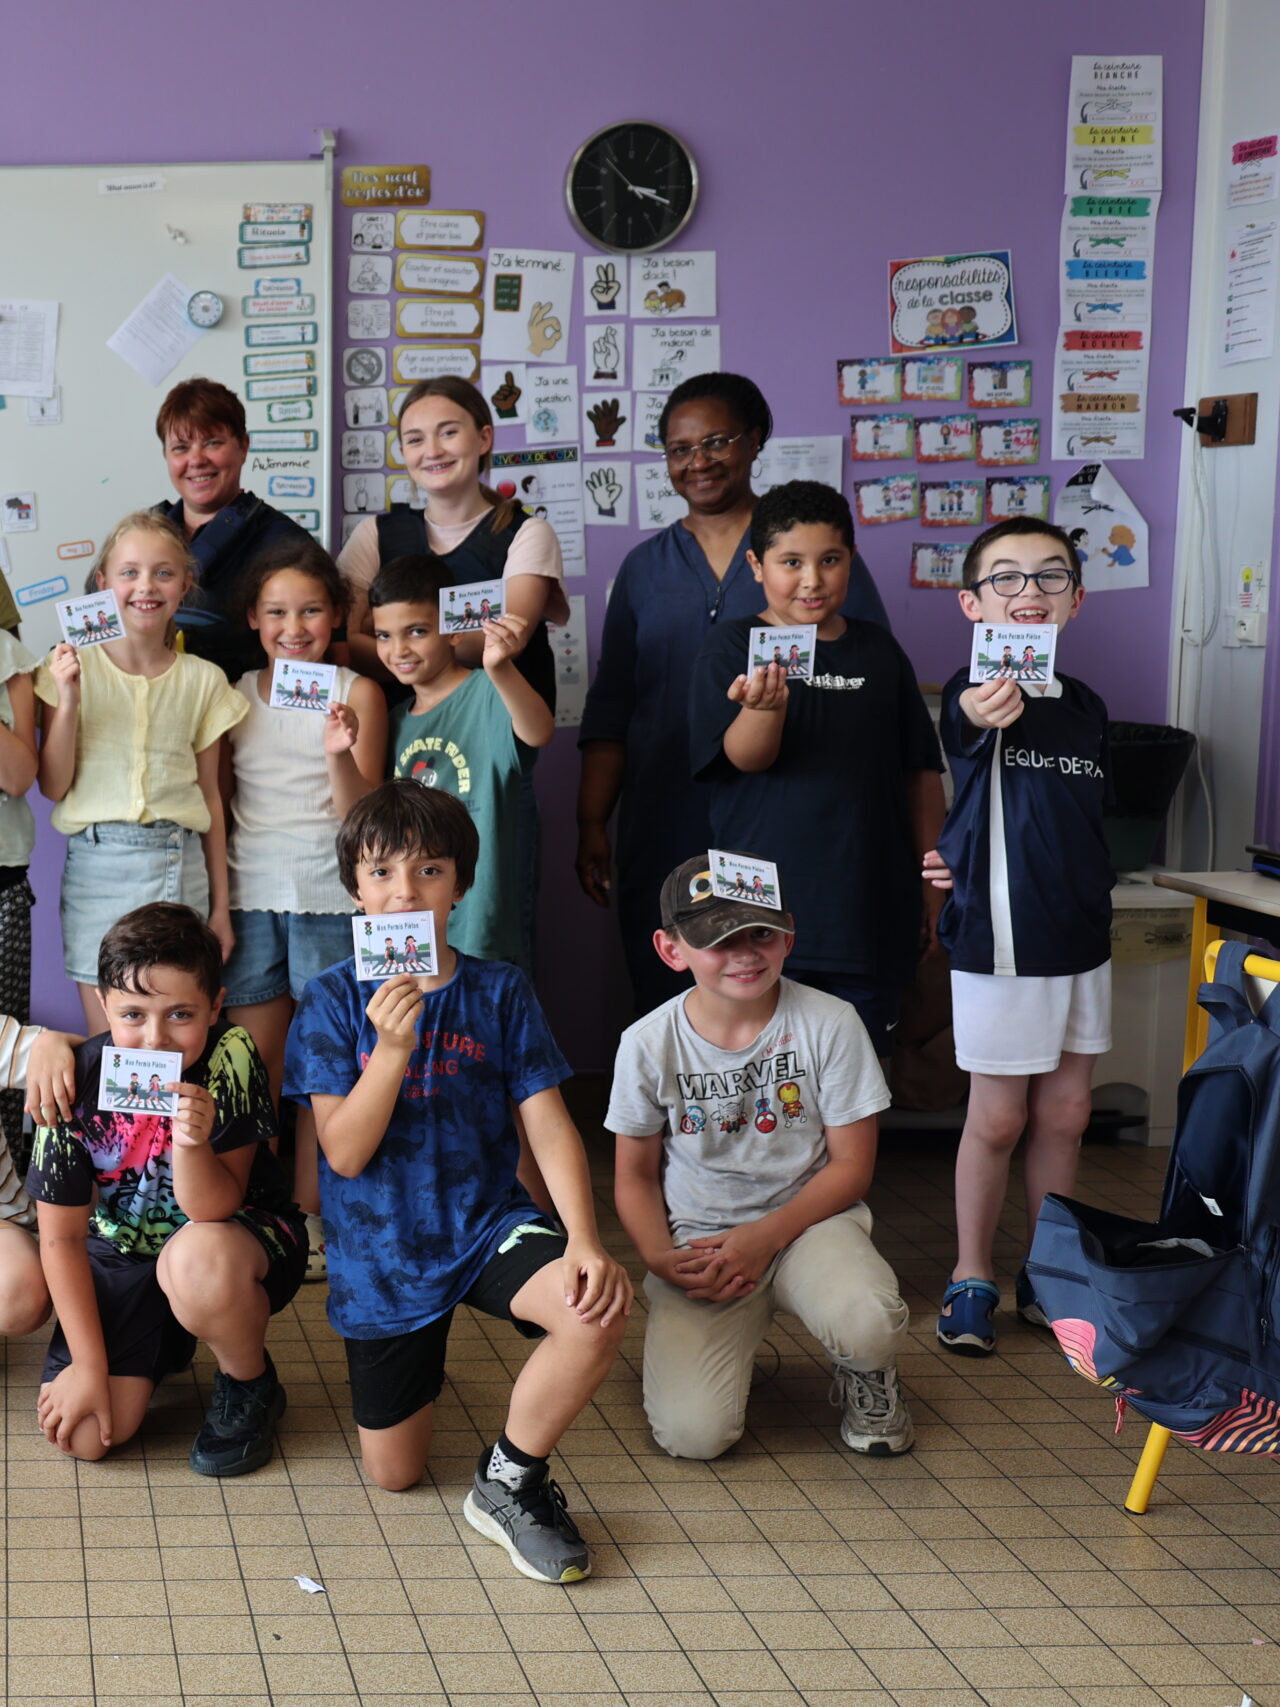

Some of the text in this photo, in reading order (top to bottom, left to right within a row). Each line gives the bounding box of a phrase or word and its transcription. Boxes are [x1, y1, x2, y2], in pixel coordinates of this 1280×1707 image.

[1094, 71, 1140, 79] BLANCHE
[1091, 135, 1135, 143] JAUNE
[663, 257, 695, 268] besoin
[897, 268, 1001, 296] responsabilités
[907, 290, 993, 309] de la classe
[669, 327, 697, 337] besoin
[552, 376, 569, 386] une
[535, 394, 572, 407] question
[252, 456, 310, 472] Autonomie
[493, 449, 575, 466] NIVEAUX DE VOIX
[997, 632, 1008, 640] Mon
[1009, 632, 1025, 640] Permis
[400, 737, 471, 794] SKATE RIDER
[676, 1051, 806, 1100] MARVEL
